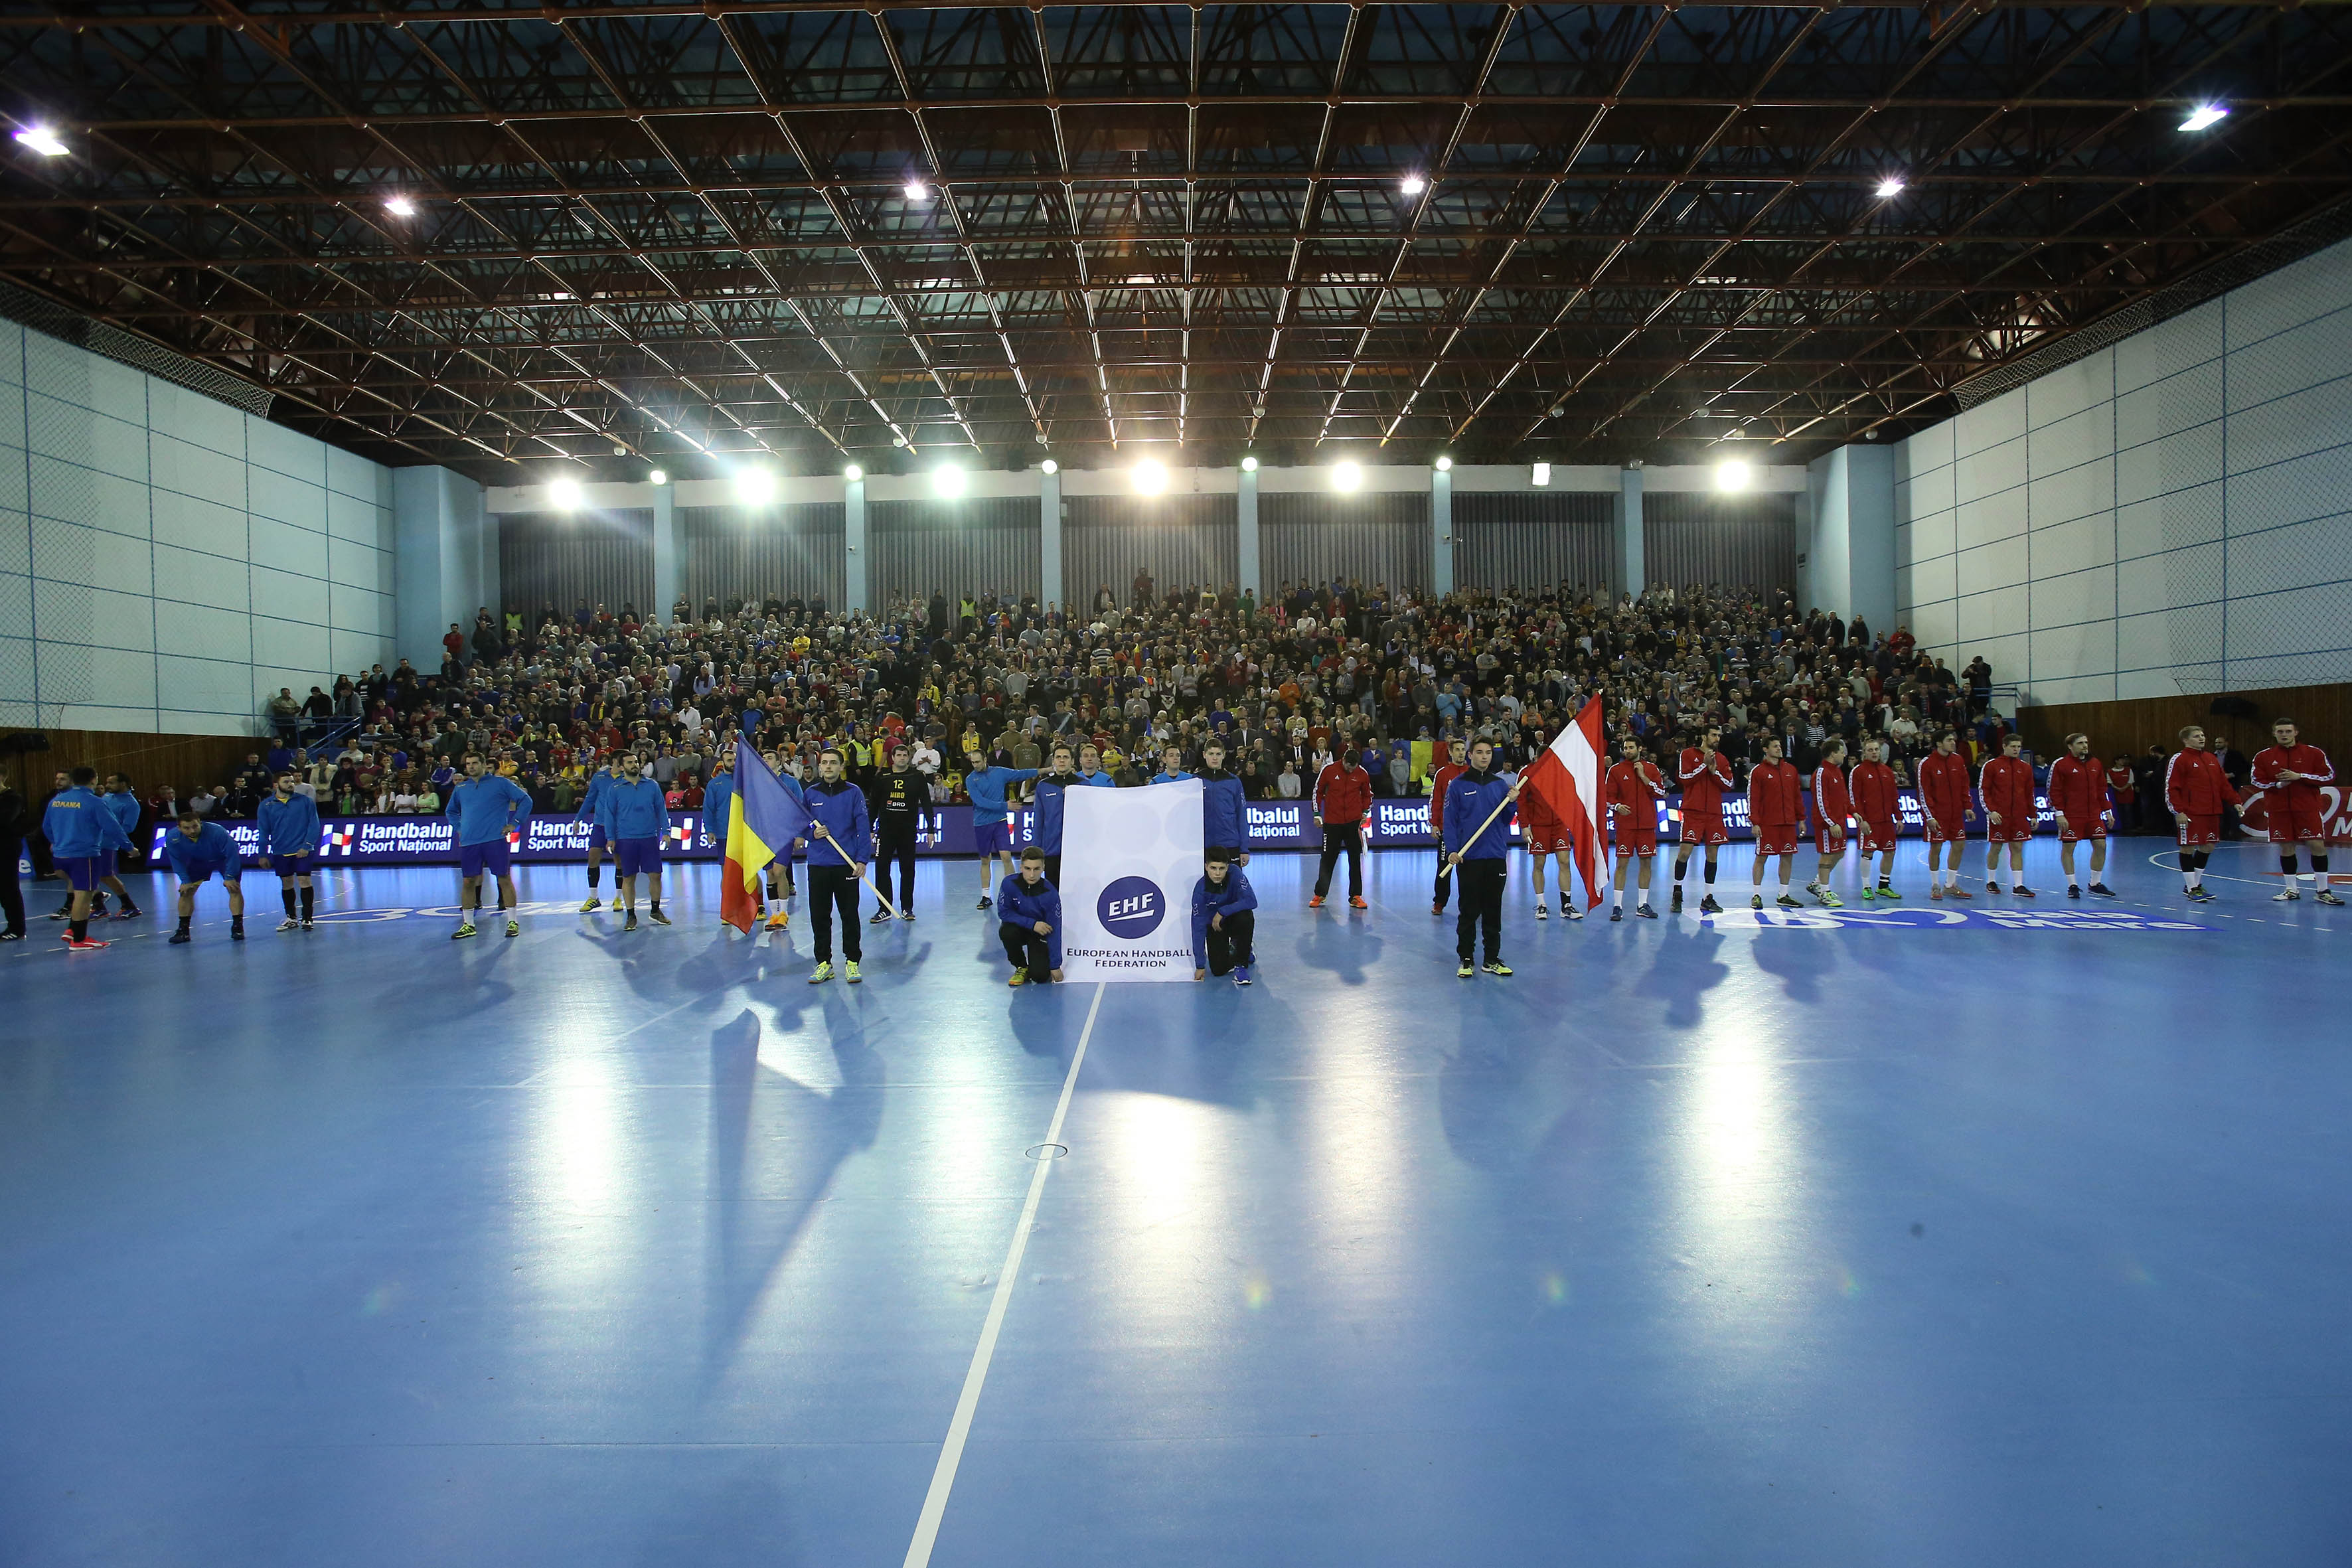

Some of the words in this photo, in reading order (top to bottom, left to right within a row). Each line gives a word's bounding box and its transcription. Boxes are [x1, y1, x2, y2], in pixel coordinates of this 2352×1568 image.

[893, 779, 903, 789] 12
[1247, 807, 1299, 823] balul
[1380, 805, 1429, 821] Hand
[361, 823, 453, 839] Handbalul
[1381, 823, 1417, 836] Sport
[359, 840, 394, 854] Sport
[528, 837, 563, 851] Sport
[1109, 892, 1154, 917] EHF
[1970, 909, 2145, 919] Baia
[1987, 919, 2207, 929] Mare
[1067, 948, 1129, 957] EUROPEAN
